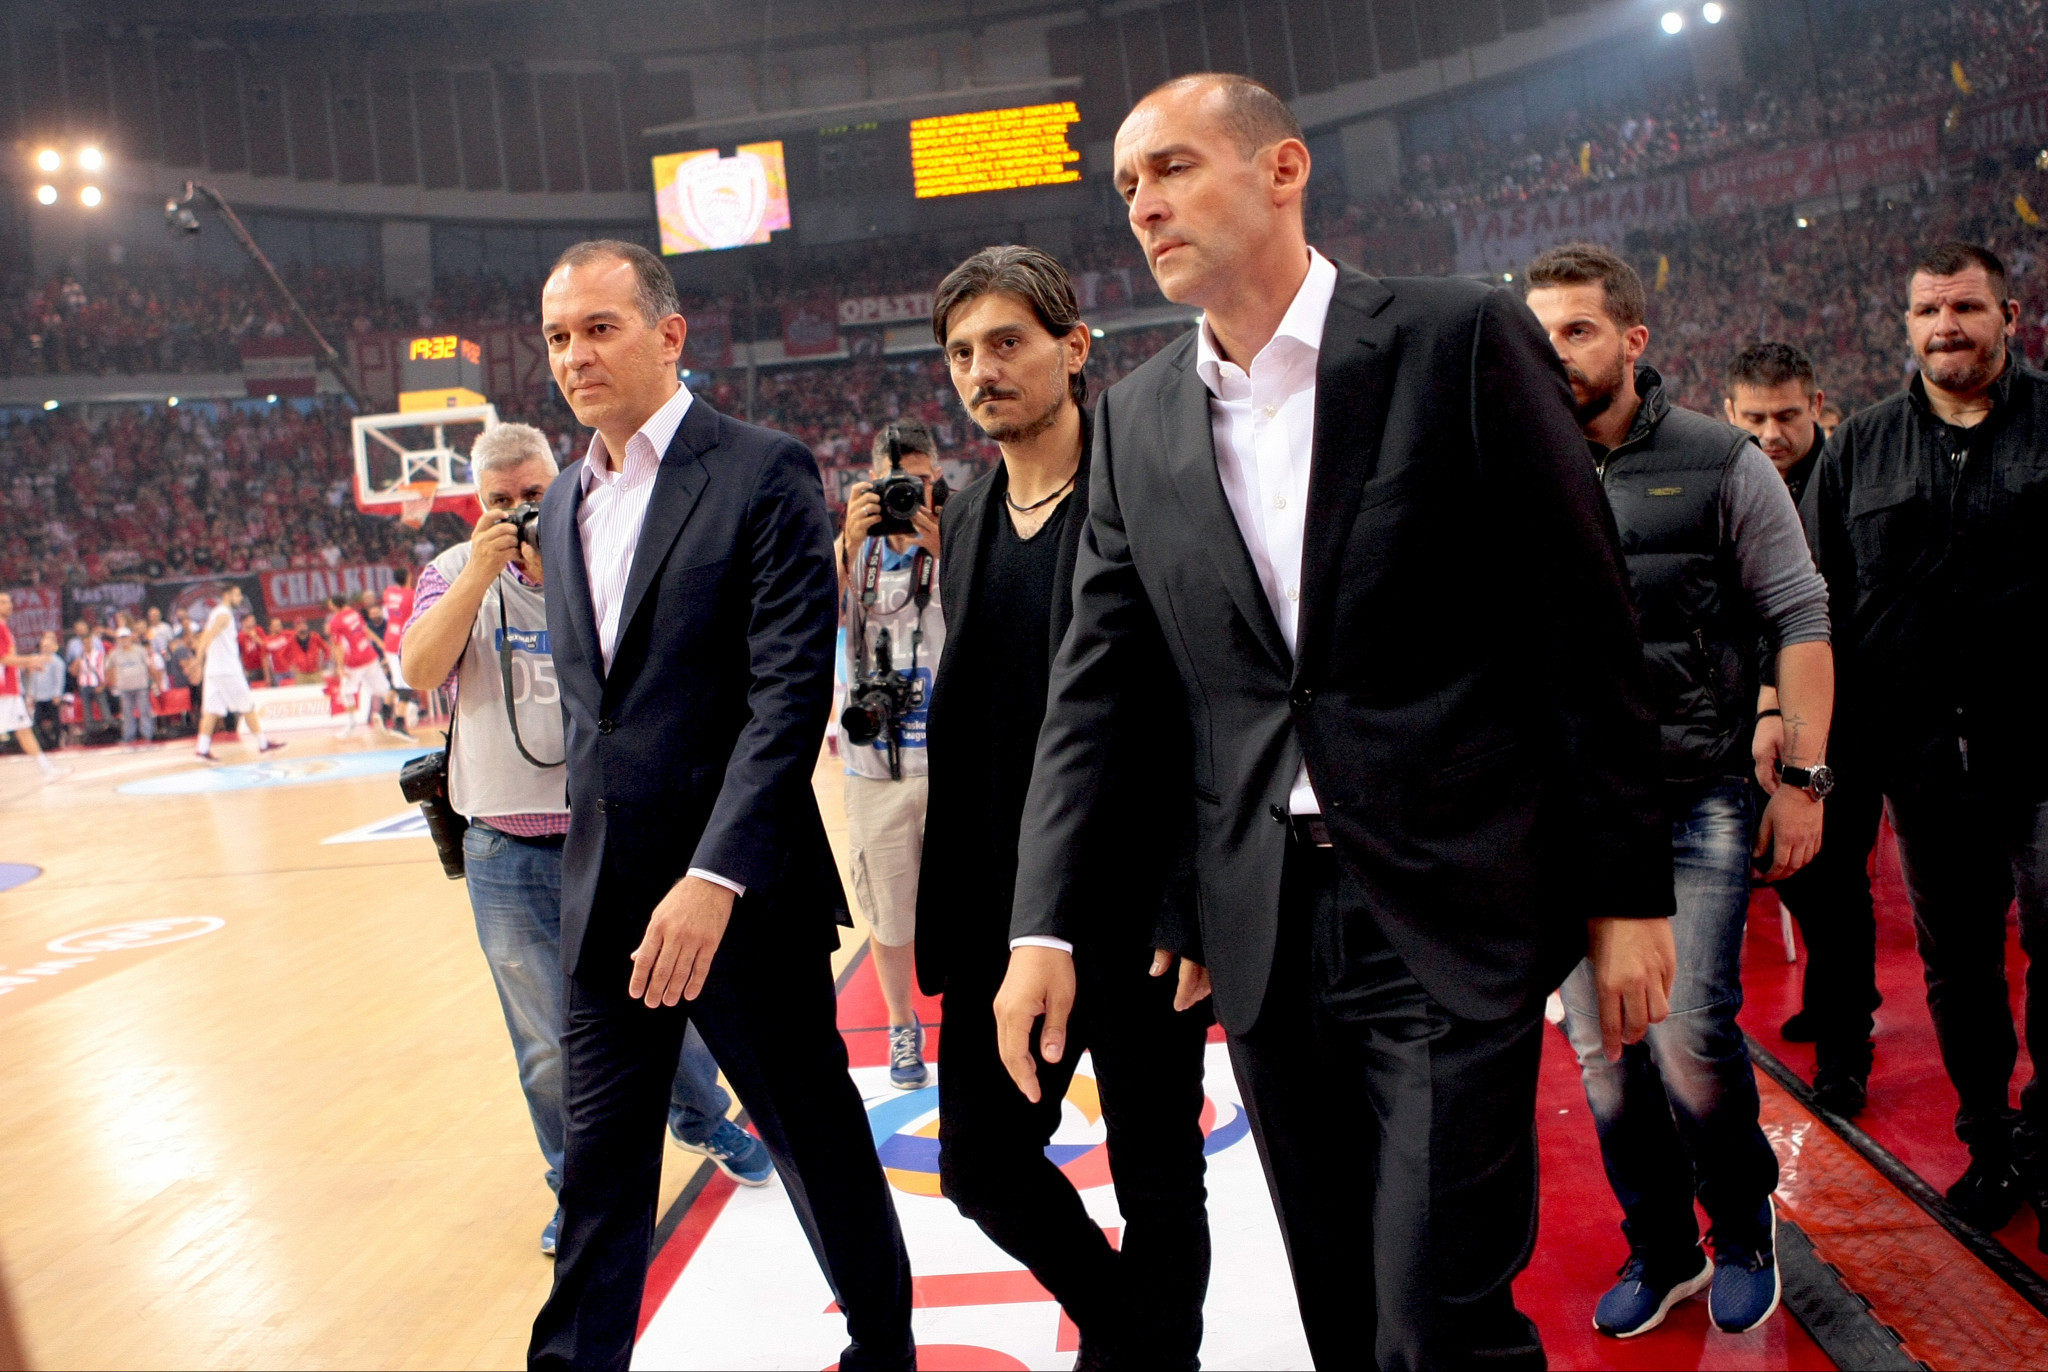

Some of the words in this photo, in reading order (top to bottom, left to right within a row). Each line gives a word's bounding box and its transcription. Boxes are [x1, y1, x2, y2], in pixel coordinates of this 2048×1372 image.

[409, 335, 458, 361] 19:32
[866, 568, 877, 589] EOS
[511, 656, 560, 705] 05
